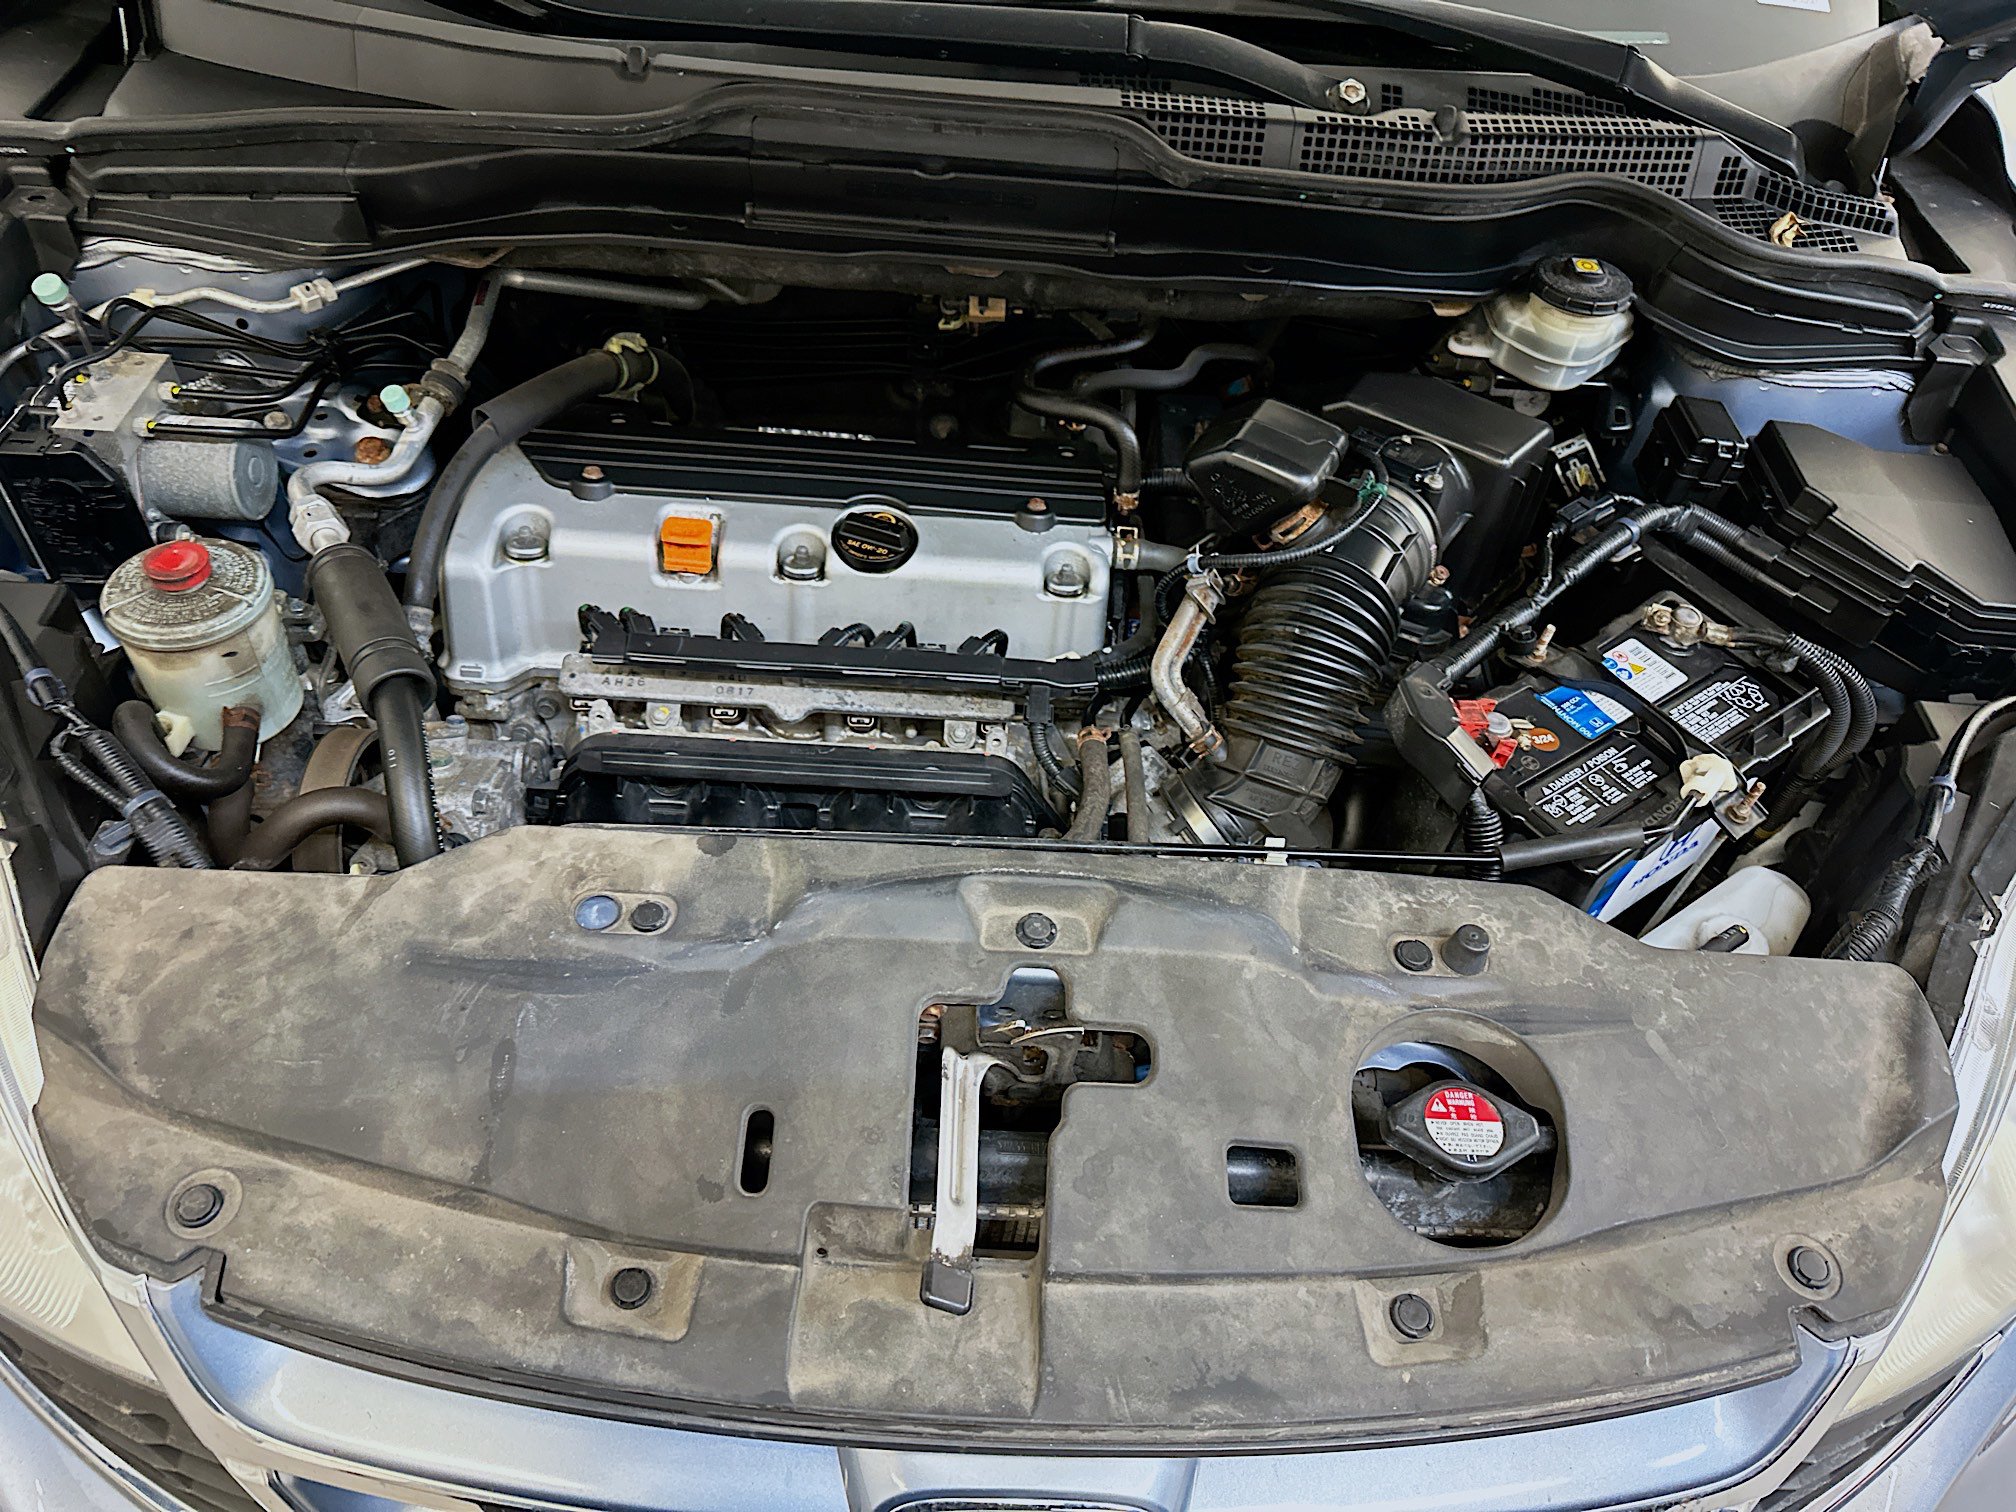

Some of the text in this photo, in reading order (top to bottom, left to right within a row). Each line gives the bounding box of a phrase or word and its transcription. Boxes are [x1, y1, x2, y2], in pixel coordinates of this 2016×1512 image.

[847, 540, 861, 548] SAE
[861, 543, 888, 555] 0W-20
[1553, 706, 1581, 728] MONTH
[1531, 733, 1555, 744] 3/24
[1548, 767, 1584, 791] DANGER
[1586, 747, 1619, 768] POISON
[1630, 841, 1698, 889] HONDA
[1444, 1090, 1474, 1099] DANGER
